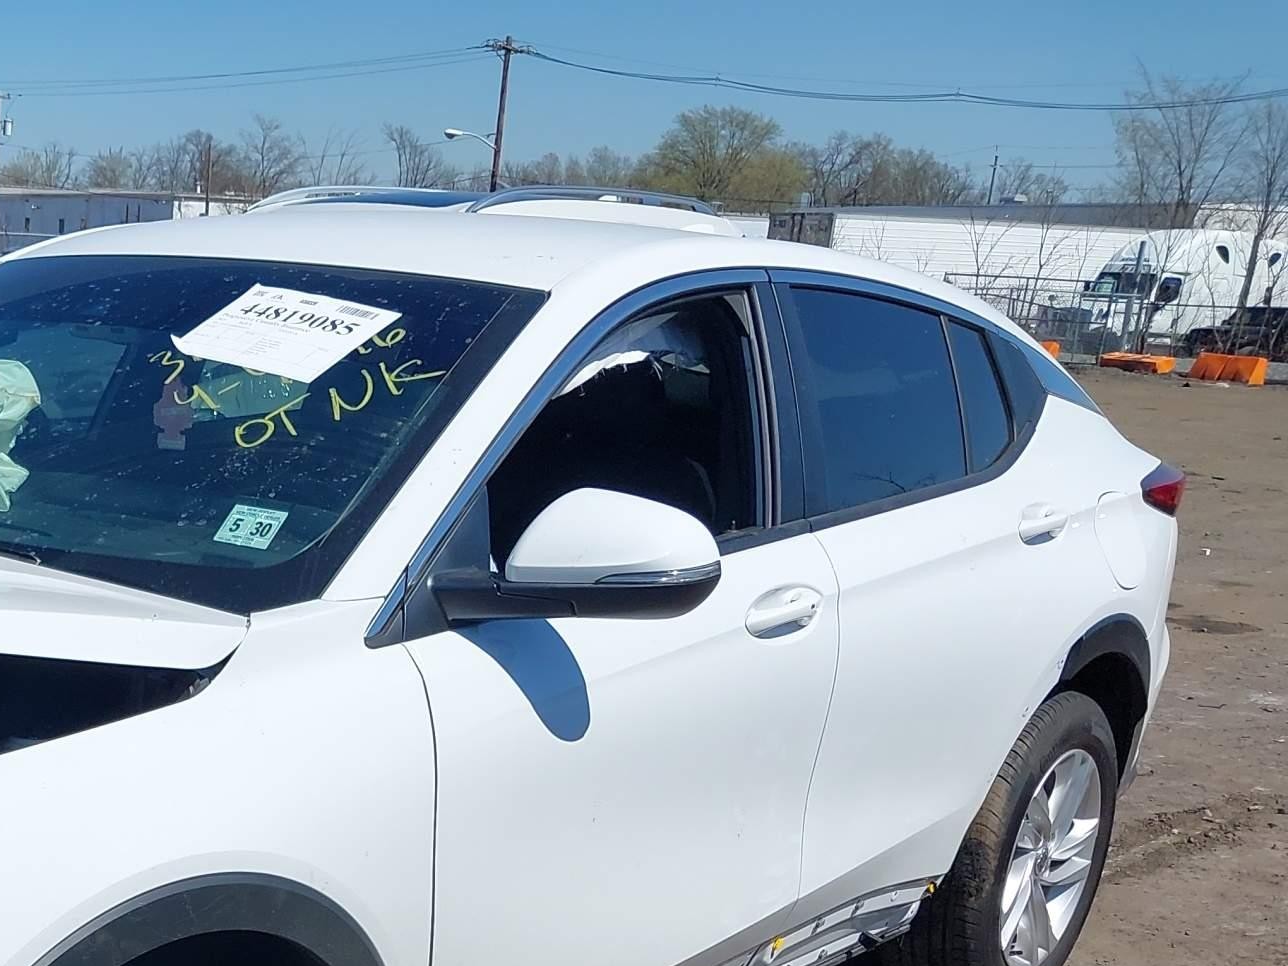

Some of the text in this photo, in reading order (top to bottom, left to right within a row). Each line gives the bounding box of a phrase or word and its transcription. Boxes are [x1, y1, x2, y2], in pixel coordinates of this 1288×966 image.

[240, 302, 361, 337] 44819085
[229, 518, 273, 537] 5 30
